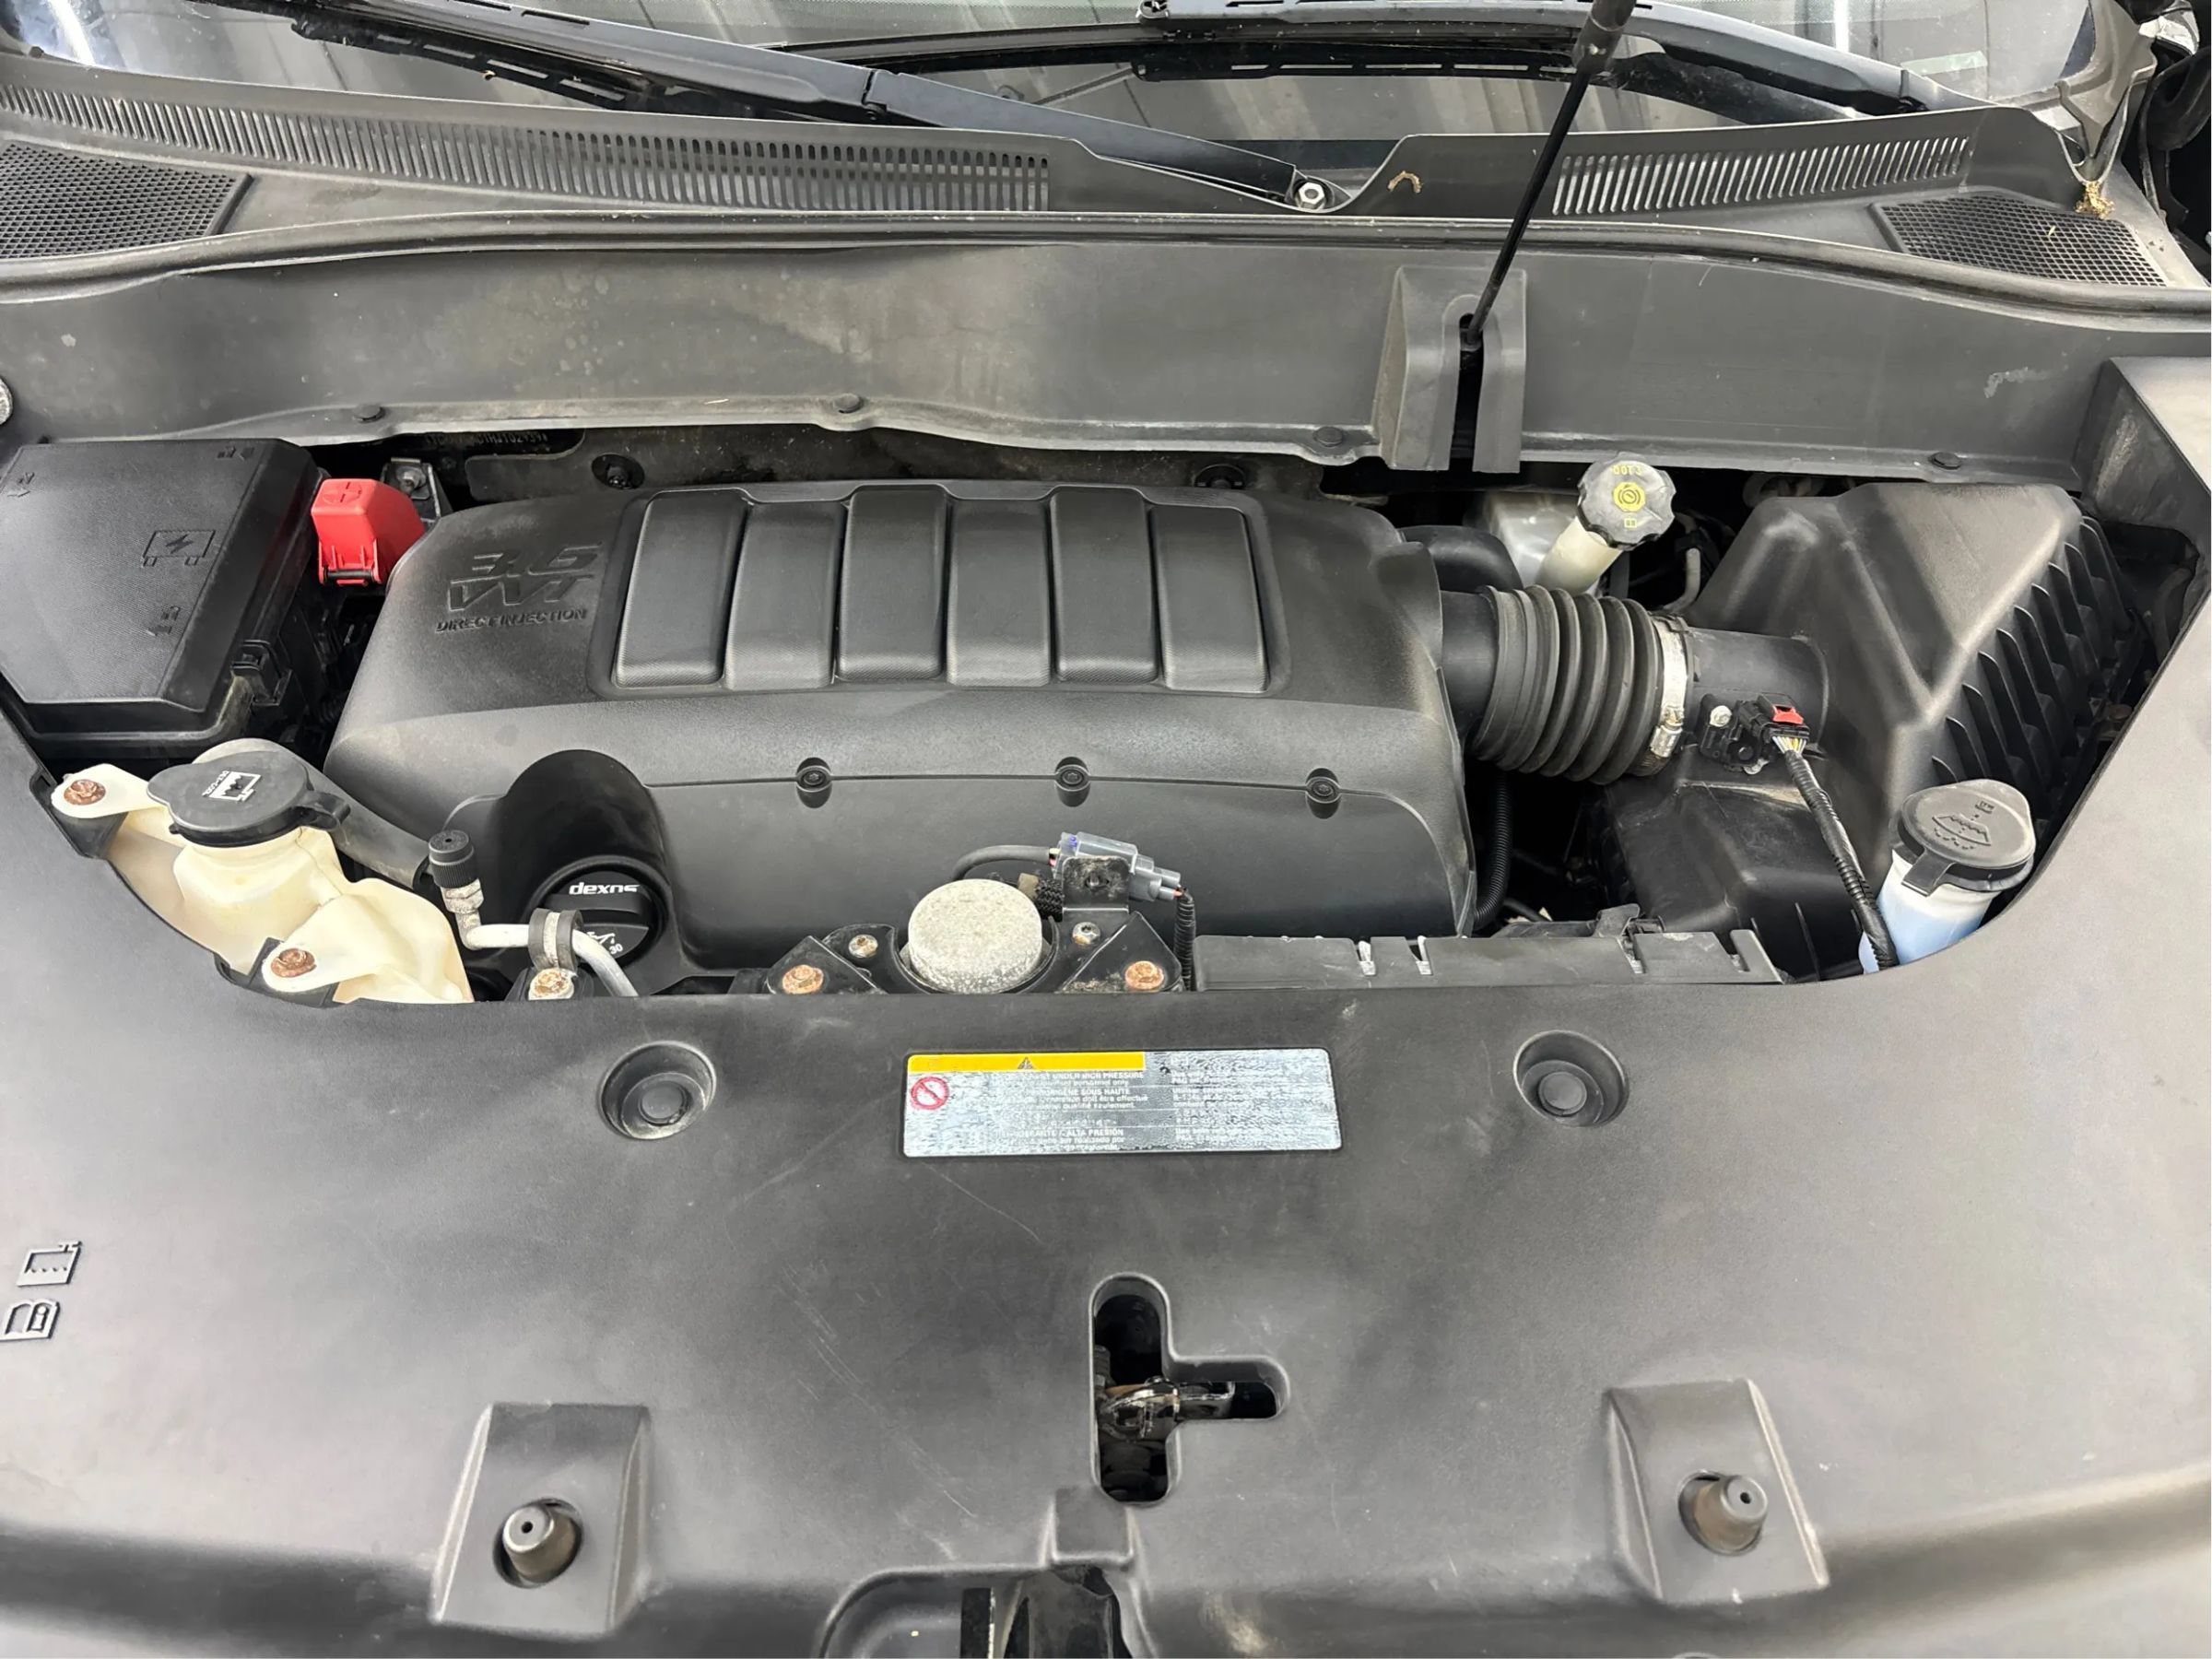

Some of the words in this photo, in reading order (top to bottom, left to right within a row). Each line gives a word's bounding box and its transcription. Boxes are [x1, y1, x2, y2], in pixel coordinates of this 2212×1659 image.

[448, 574, 594, 611] VVT
[435, 615, 497, 634] DIRECT
[497, 607, 588, 628] INJECTION
[1103, 1071, 1144, 1079] PRESSURE
